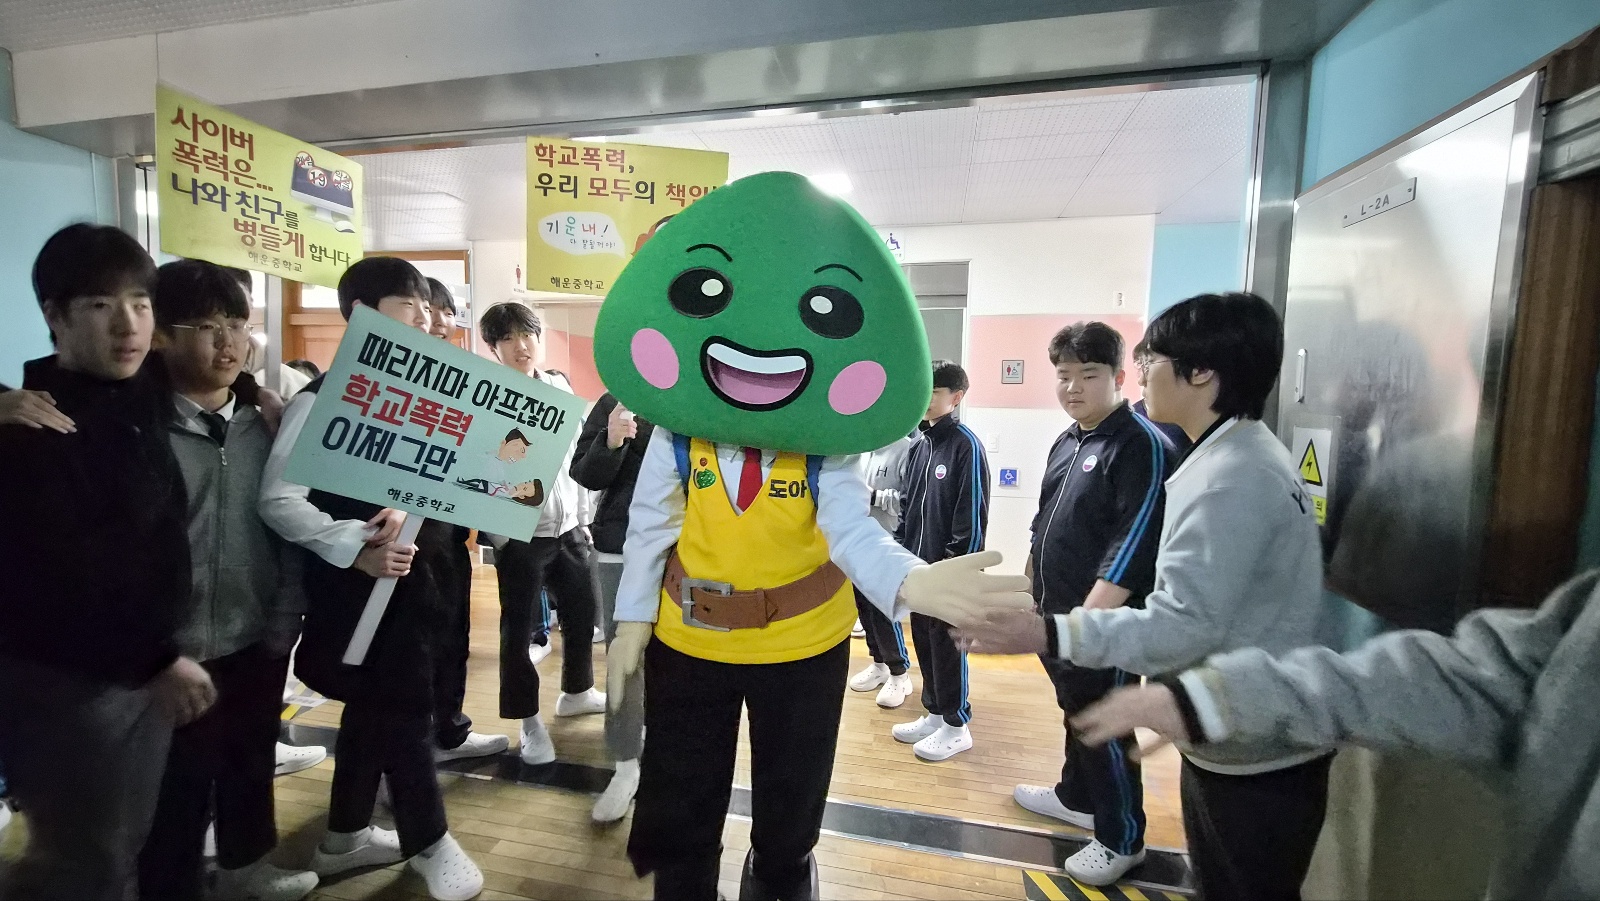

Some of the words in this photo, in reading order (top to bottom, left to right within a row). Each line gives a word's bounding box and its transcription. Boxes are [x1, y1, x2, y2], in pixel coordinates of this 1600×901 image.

[171, 104, 254, 161] 사이버
[172, 138, 273, 191] 폭력은...
[535, 143, 634, 174] 학교폭력,
[172, 172, 231, 212] 나와
[235, 190, 299, 229] 친구를
[535, 172, 578, 198] 우리
[588, 177, 655, 204] 모두의
[1360, 194, 1390, 216] L-2A
[233, 218, 304, 258] 병들게
[309, 243, 351, 269] 합니다
[248, 251, 302, 272] 해운중학교
[550, 276, 605, 290] 해운중학교
[357, 332, 470, 399] 때리지마
[472, 379, 565, 434] 아프잖아
[341, 373, 474, 447] 학교폭력
[322, 416, 457, 483] 이제그만
[387, 487, 456, 514] 해운중학교
[768, 479, 808, 498] 도아
